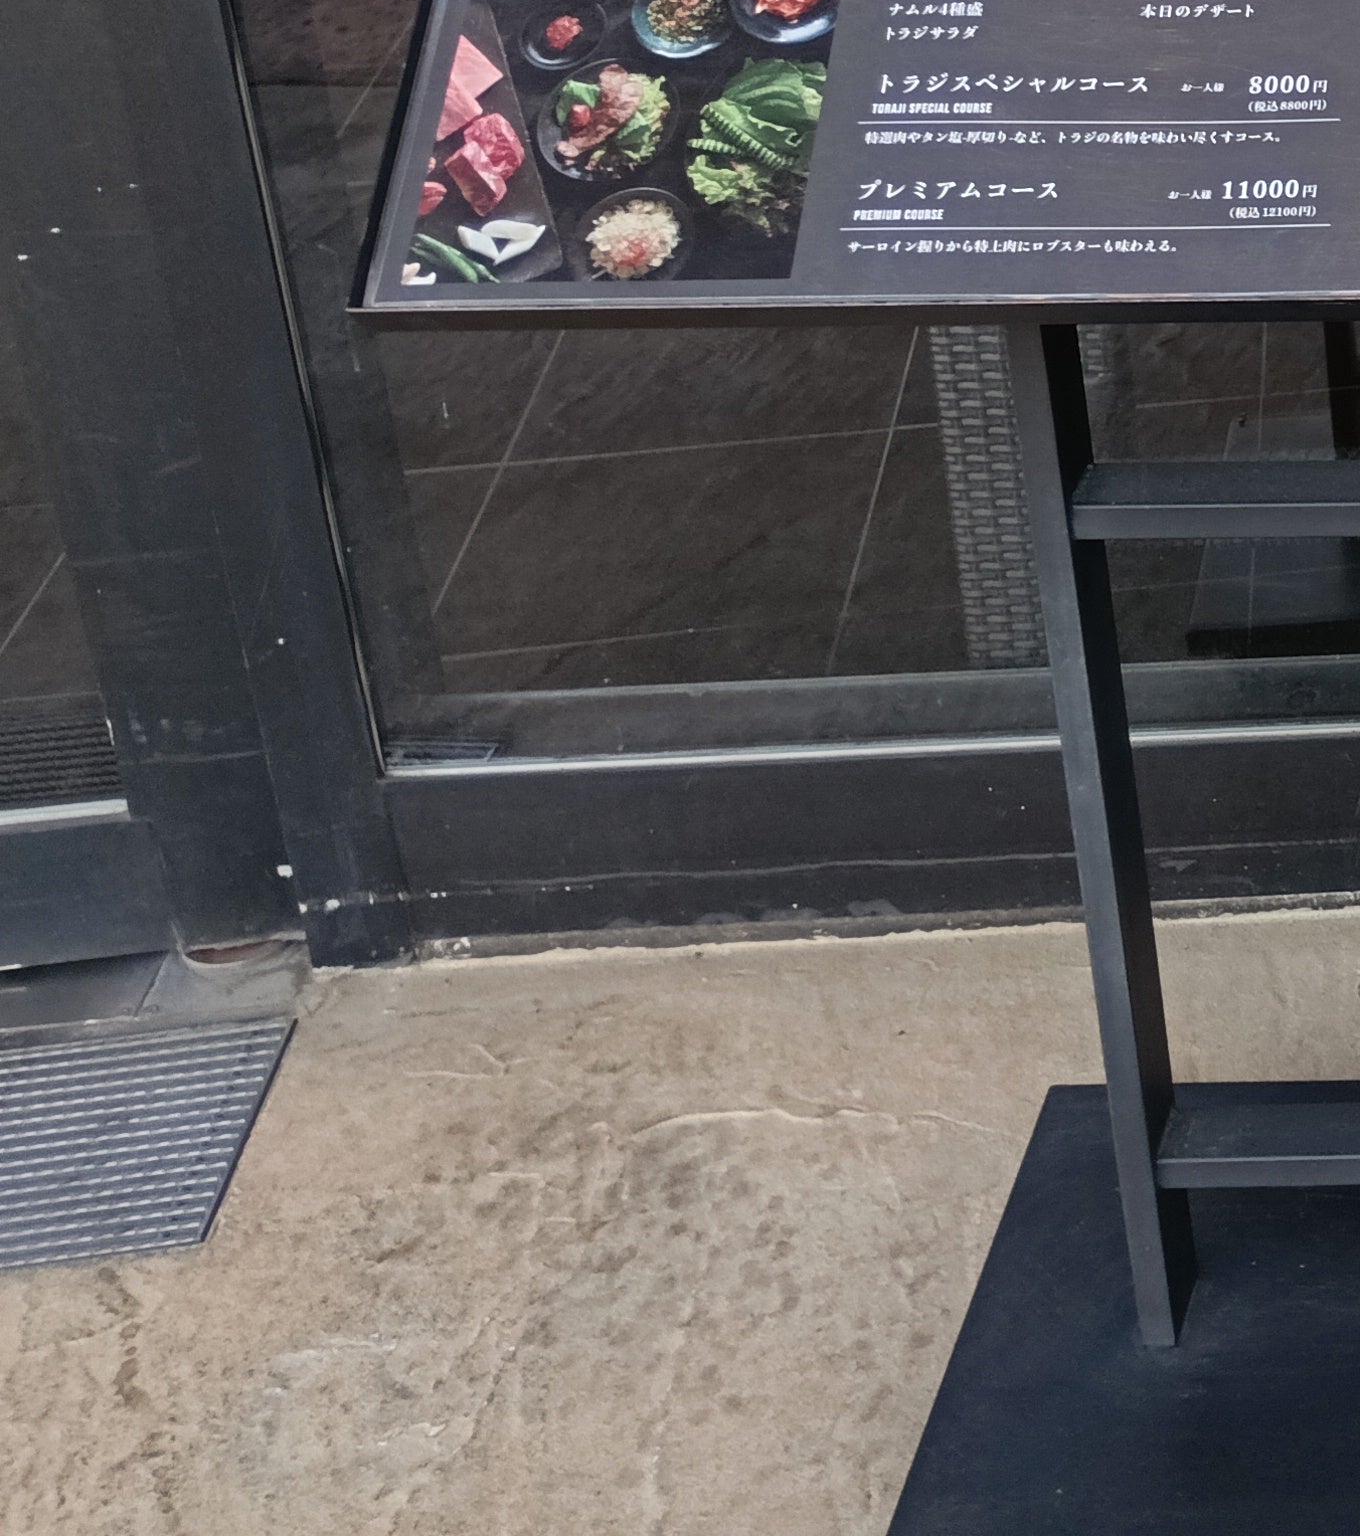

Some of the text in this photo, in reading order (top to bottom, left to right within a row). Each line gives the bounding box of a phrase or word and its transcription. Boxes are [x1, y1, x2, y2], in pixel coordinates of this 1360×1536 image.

[889, 1, 984, 17] ナムル4種盛
[1139, 3, 1255, 19] 本日のデザート
[886, 25, 979, 41] トラジサラダ
[880, 72, 1148, 94] トラジスペシャルコース
[1180, 82, 1225, 93] お一人様
[908, 102, 993, 114] SPECIAL COURSE
[1247, 99, 1327, 113] (税込8800円)
[858, 178, 1058, 200] プレミアムコース
[1167, 189, 1212, 200] お一人様
[1221, 179, 1318, 200] 11000円
[852, 208, 945, 221] PREMIUM COURSE
[1229, 205, 1317, 219] (税込12100円)
